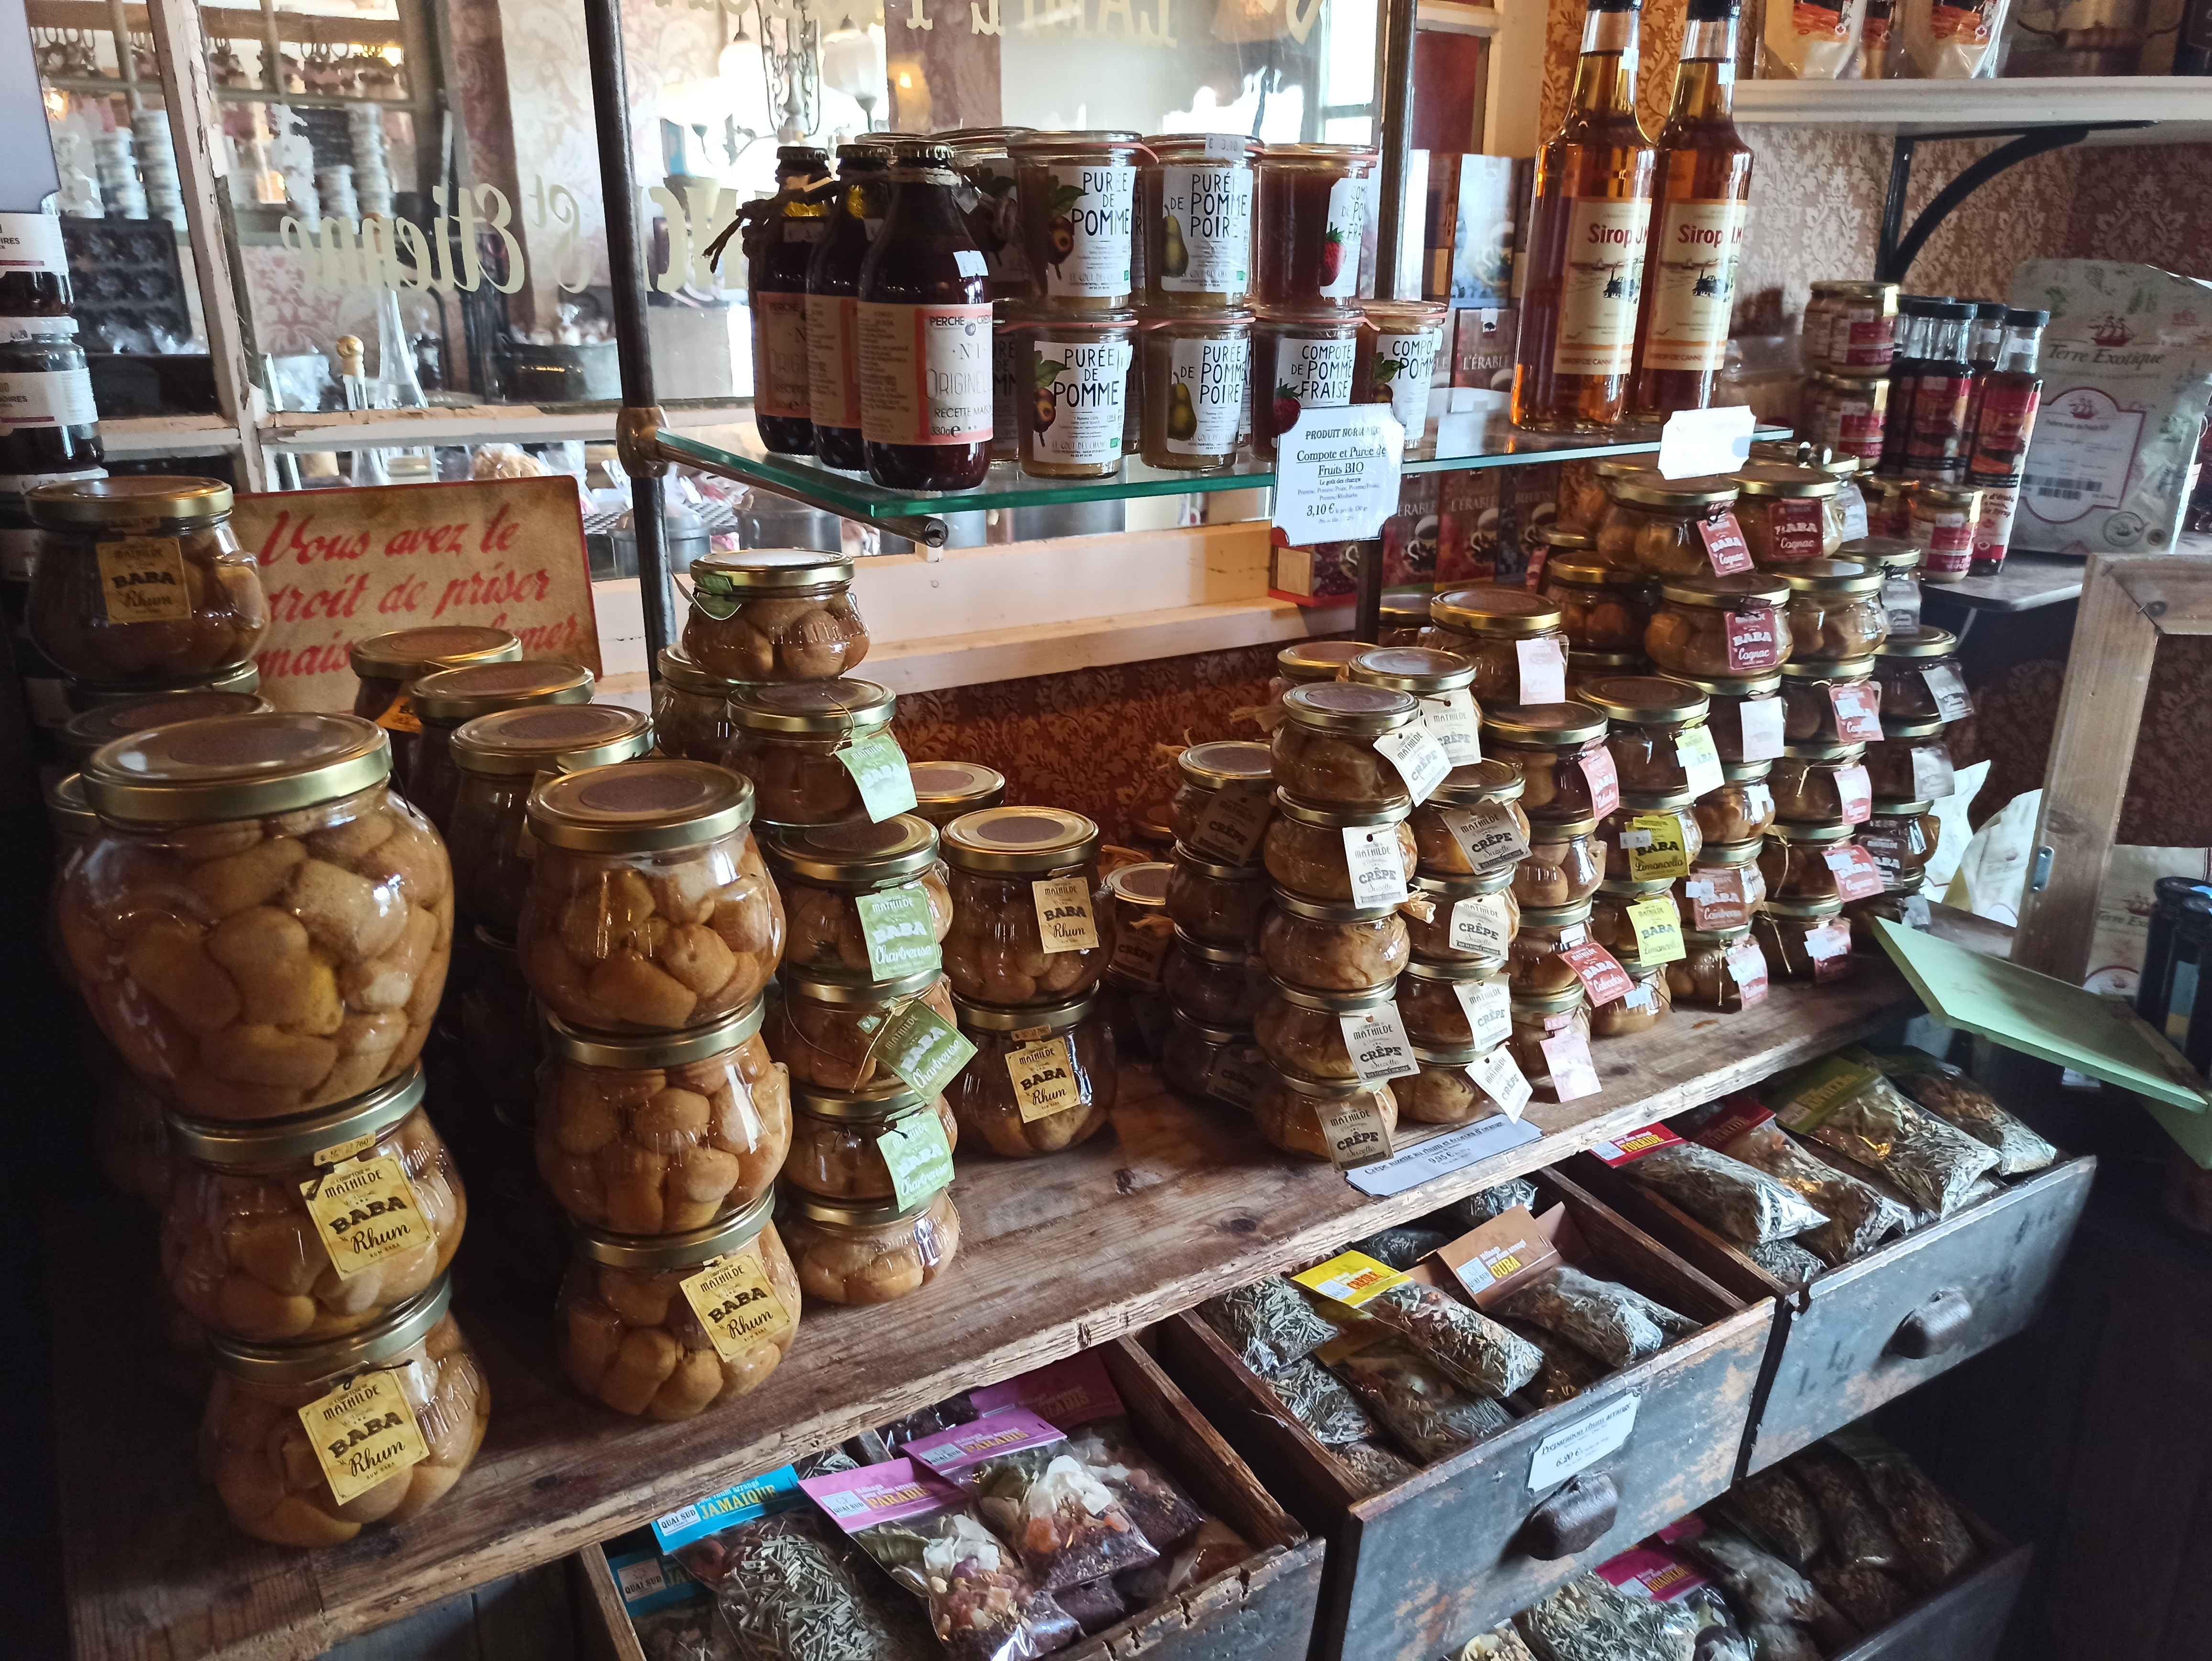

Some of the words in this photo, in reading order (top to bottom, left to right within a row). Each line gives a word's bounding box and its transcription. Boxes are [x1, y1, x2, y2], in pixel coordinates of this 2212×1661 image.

[1103, 193, 1115, 208] DE
[1170, 197, 1184, 210] DE
[1190, 193, 1247, 217] POMME
[1071, 208, 1130, 236] POMME
[1588, 223, 1632, 249] Sirop
[1678, 224, 1723, 248] Sirop
[929, 316, 965, 326] PERCHE
[1064, 344, 1115, 368] PURÉE
[1203, 343, 1242, 363] PURÉE
[1302, 344, 1351, 361] COMPOTE
[2048, 343, 2088, 360] Terre
[2093, 347, 2166, 371] Exotique
[1084, 368, 1098, 382] DE
[1180, 365, 1195, 379] DE
[1201, 361, 1245, 384] POMME
[1291, 363, 1304, 376] DE
[1307, 359, 1353, 381] POMME
[1053, 381, 1120, 408] POMME
[1200, 384, 1239, 404] POIRE
[1300, 381, 1348, 399] FRAISE
[934, 407, 972, 418] RECETTE
[1305, 429, 1341, 440] PRODUIT
[1296, 450, 1337, 462] Compote
[1339, 450, 1348, 458] et
[1376, 444, 1386, 455] de
[1318, 464, 1342, 476] Fruits
[1345, 462, 1364, 474] BIO
[1306, 504, 1326, 517] 3,10
[1328, 503, 1335, 514] €
[258, 509, 371, 566] Vous
[384, 523, 470, 557] avez
[480, 503, 520, 554] le
[1780, 537, 1814, 550] Cognac
[111, 571, 176, 588] BABA
[123, 589, 172, 609] Rhum
[378, 573, 429, 615] de
[432, 562, 551, 620] priser
[1732, 631, 1772, 646] BABA
[1738, 647, 1770, 661] Cognac
[1433, 711, 1467, 723] MATHILDE
[1397, 731, 1424, 761] MATHILDE
[1460, 814, 1500, 833] MATHILDE
[1471, 831, 1513, 853] CRÊPE
[1635, 841, 1680, 856] BABA
[1354, 846, 1391, 859] MATHILDE
[1359, 866, 1396, 884] CRÊPE
[1635, 859, 1684, 872] Limoncello
[872, 897, 914, 913] MATHILDE
[1043, 906, 1087, 921] BABA
[871, 921, 928, 944] BABA
[1052, 922, 1086, 938] Rhum
[1459, 922, 1499, 941] CRÊPE
[1641, 924, 1675, 940] BABA
[875, 944, 932, 965] Chartreuse
[1593, 973, 1625, 993] Calvados
[1477, 1007, 1505, 1028] CRÊPE
[1353, 1024, 1394, 1041] MATHILDE
[900, 1025, 947, 1073] BABA
[1019, 1047, 1055, 1065] MATHILDE
[1360, 1045, 1403, 1063] CRÊPE
[912, 1039, 962, 1089] Chartreuse
[1371, 1059, 1400, 1070] Suzette
[1020, 1067, 1067, 1091] BABA
[1031, 1087, 1067, 1106] Rhum
[1330, 1109, 1371, 1127] MATHILDE
[1337, 1130, 1379, 1151] CRÊPE
[1620, 1133, 1665, 1153] TORRIDE
[1364, 1163, 1388, 1175] Crêpe
[324, 1170, 383, 1199] MATHILDE
[901, 1163, 949, 1197] Chartreuse
[328, 1196, 408, 1235] BABA
[350, 1224, 411, 1254] Rhum
[369, 1249, 383, 1258] RUM
[1490, 1255, 1522, 1279] CUBA
[700, 1264, 745, 1293] MATHILDE
[708, 1287, 768, 1324] BABA
[726, 1310, 774, 1340] Rhum
[322, 1384, 381, 1421] MATHILDE
[328, 1412, 404, 1459] BABA
[963, 1430, 1029, 1454] PARADIS
[349, 1441, 406, 1477] Rhum
[733, 1478, 760, 1493] arrangé
[865, 1485, 933, 1509] PARADIS
[661, 1515, 680, 1529] QUAI
[680, 1508, 697, 1520] SUD
[625, 1582, 647, 1595] QUAI
[646, 1574, 663, 1585] SUD
